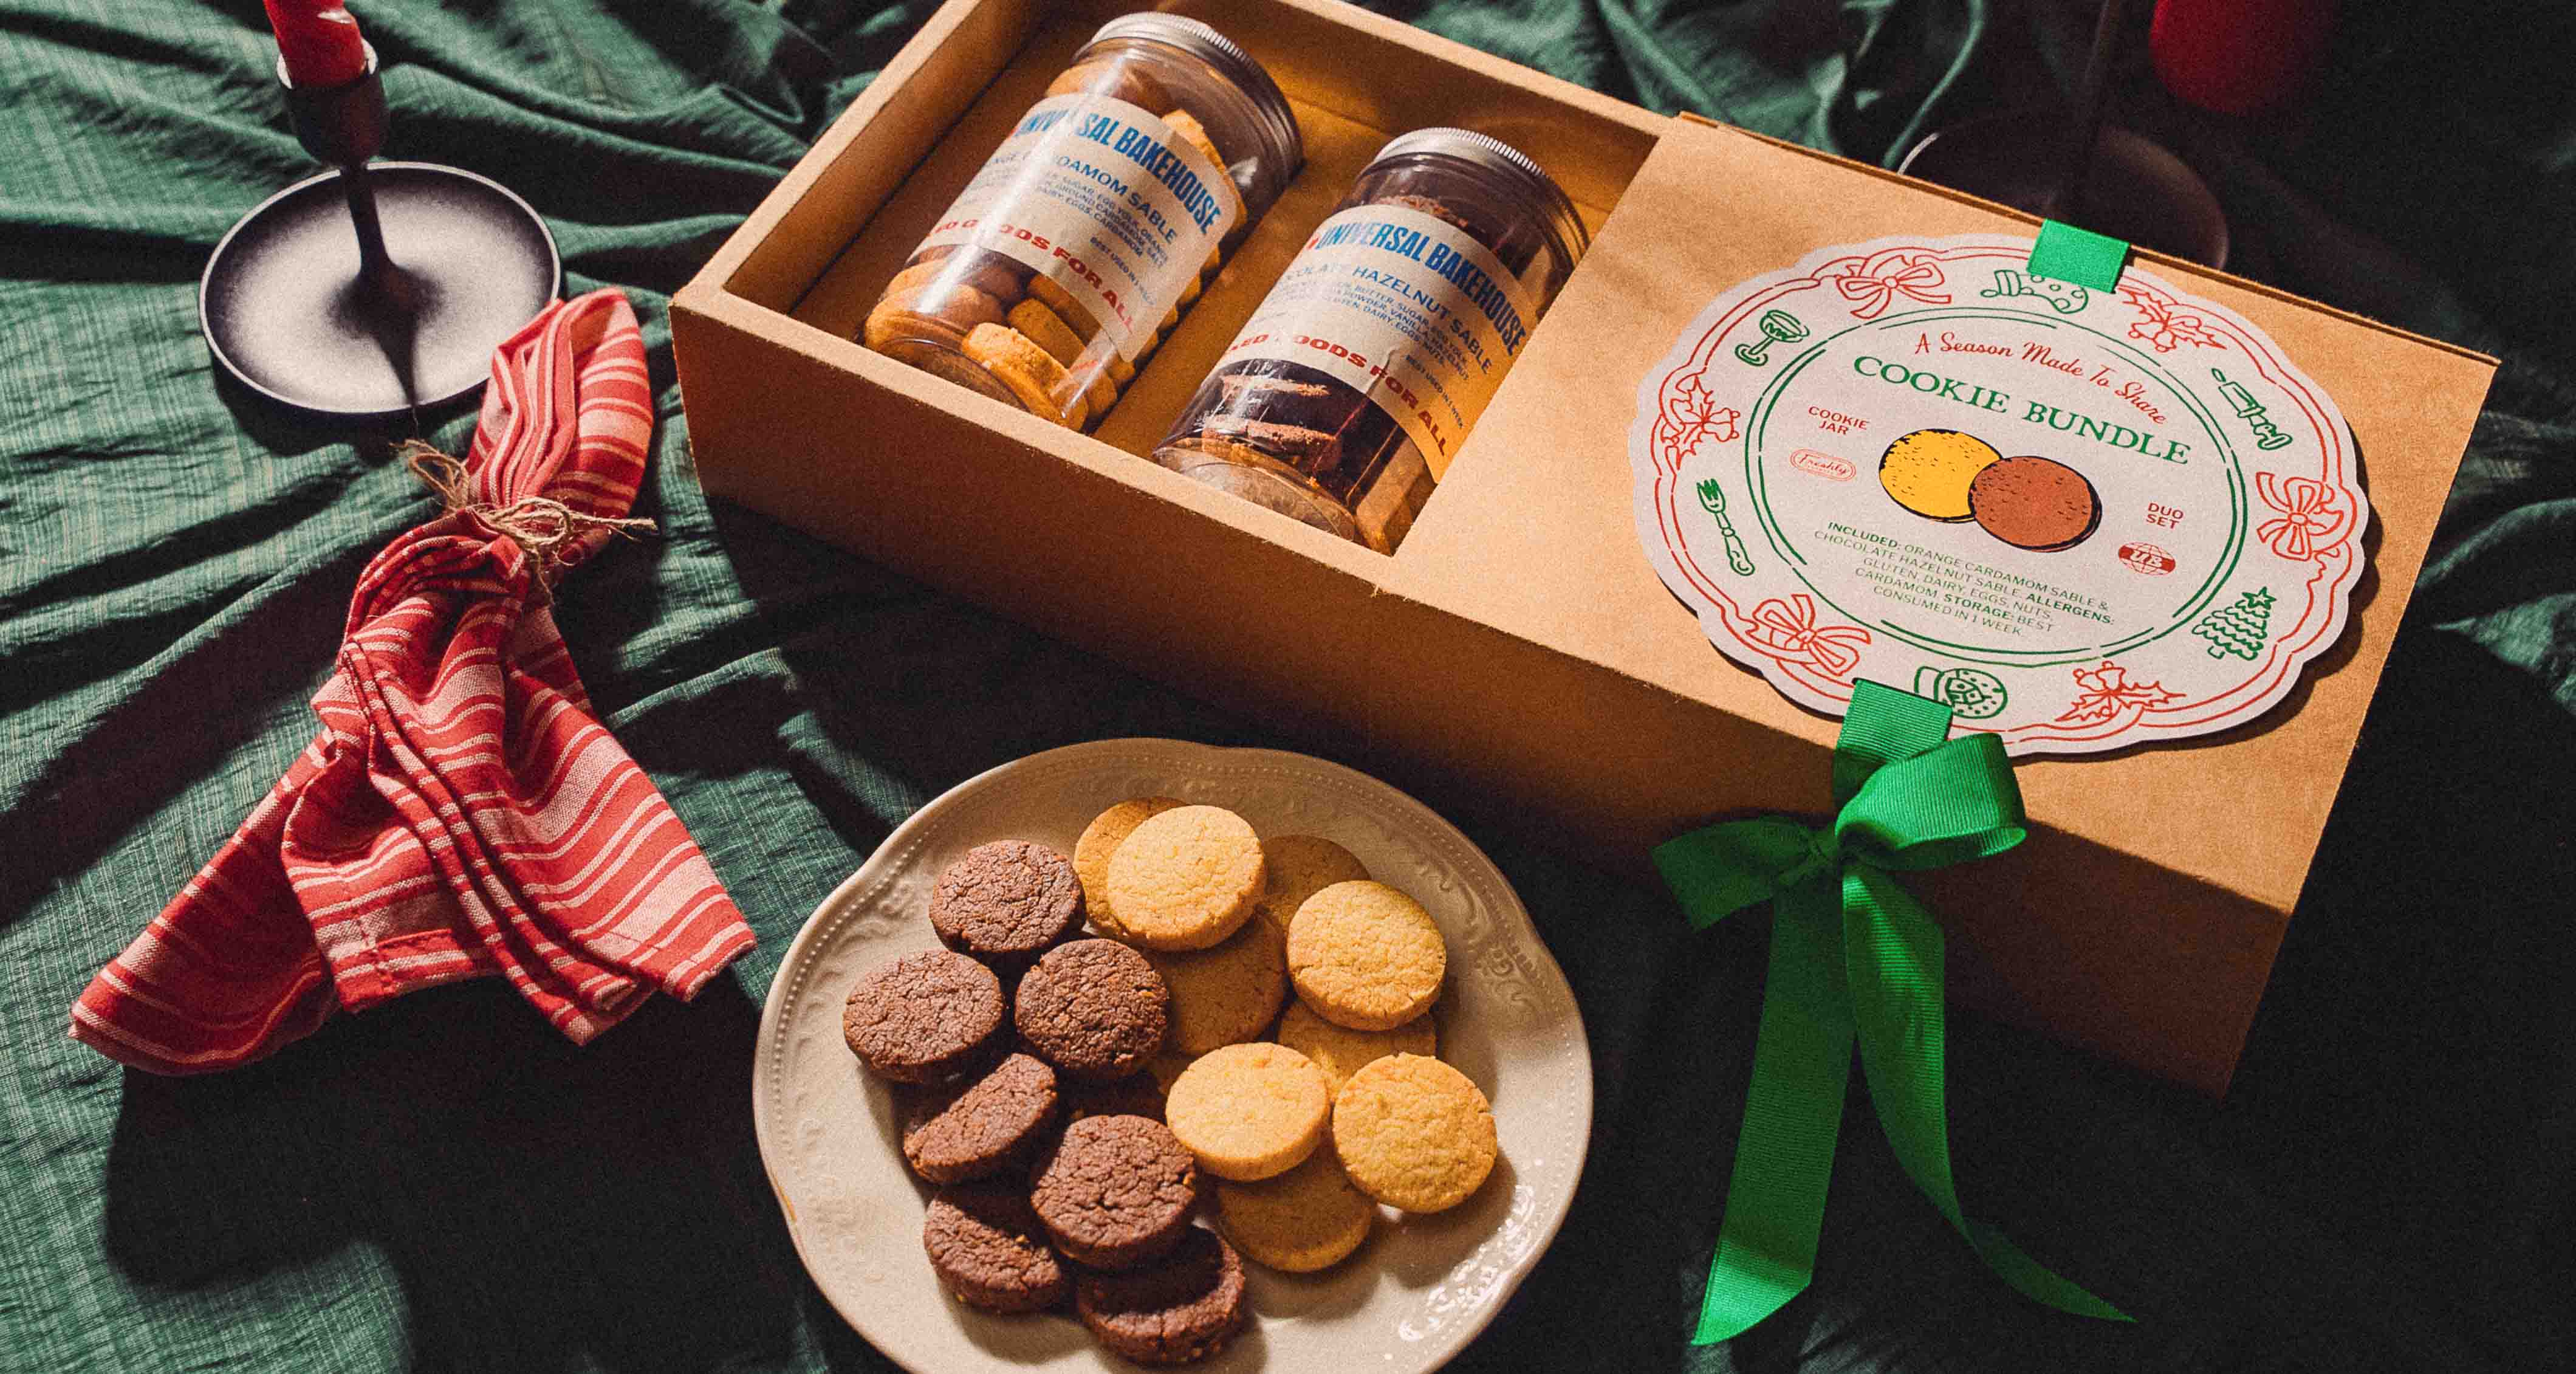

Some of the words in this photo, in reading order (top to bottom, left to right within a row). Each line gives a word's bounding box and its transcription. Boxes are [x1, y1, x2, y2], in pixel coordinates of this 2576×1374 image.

[1114, 126, 1221, 234] BAKEHOUSE
[1128, 191, 1177, 243] SABLE
[1053, 246, 1103, 289] FOR
[1102, 290, 1134, 335] ALL
[1424, 242, 1527, 356] BAKEHOUSE
[1352, 266, 1450, 320] HAZELNUT
[1450, 318, 1493, 374] SABLE
[1914, 332, 1930, 354] A
[1940, 331, 2013, 357] Season
[2021, 340, 2084, 376] Made
[2089, 363, 2118, 388] To
[2113, 380, 2167, 425] Share
[1369, 365, 1419, 410] FOR
[1417, 410, 1447, 456] ALL
[1808, 406, 1870, 430] COOKIE
[1818, 420, 1849, 435] JAR
[1853, 356, 2011, 414] COOKIE
[2021, 400, 2192, 465] BUNDLE
[1798, 453, 1848, 476] Freshly
[2146, 514, 2180, 529] SET
[2148, 502, 2184, 520] DUO
[1814, 530, 1897, 560] CHOCOLATE
[1899, 555, 1972, 583] HAZELNUT
[2026, 593, 2115, 625] ALLERGENS:
[1828, 521, 1901, 549] INCLUDED:
[1905, 544, 1963, 568] ORANGE
[1965, 561, 2047, 593] CARDAMOM
[2050, 586, 2096, 608] SABLE
[2098, 600, 2109, 611] &
[2129, 549, 2163, 568] UB
[1873, 584, 1952, 616] CONSUMED
[1953, 609, 1970, 621] IN
[1944, 593, 2015, 620] STORAGE:
[2017, 615, 2055, 633] BEST
[1970, 588, 2010, 608] EGGS,
